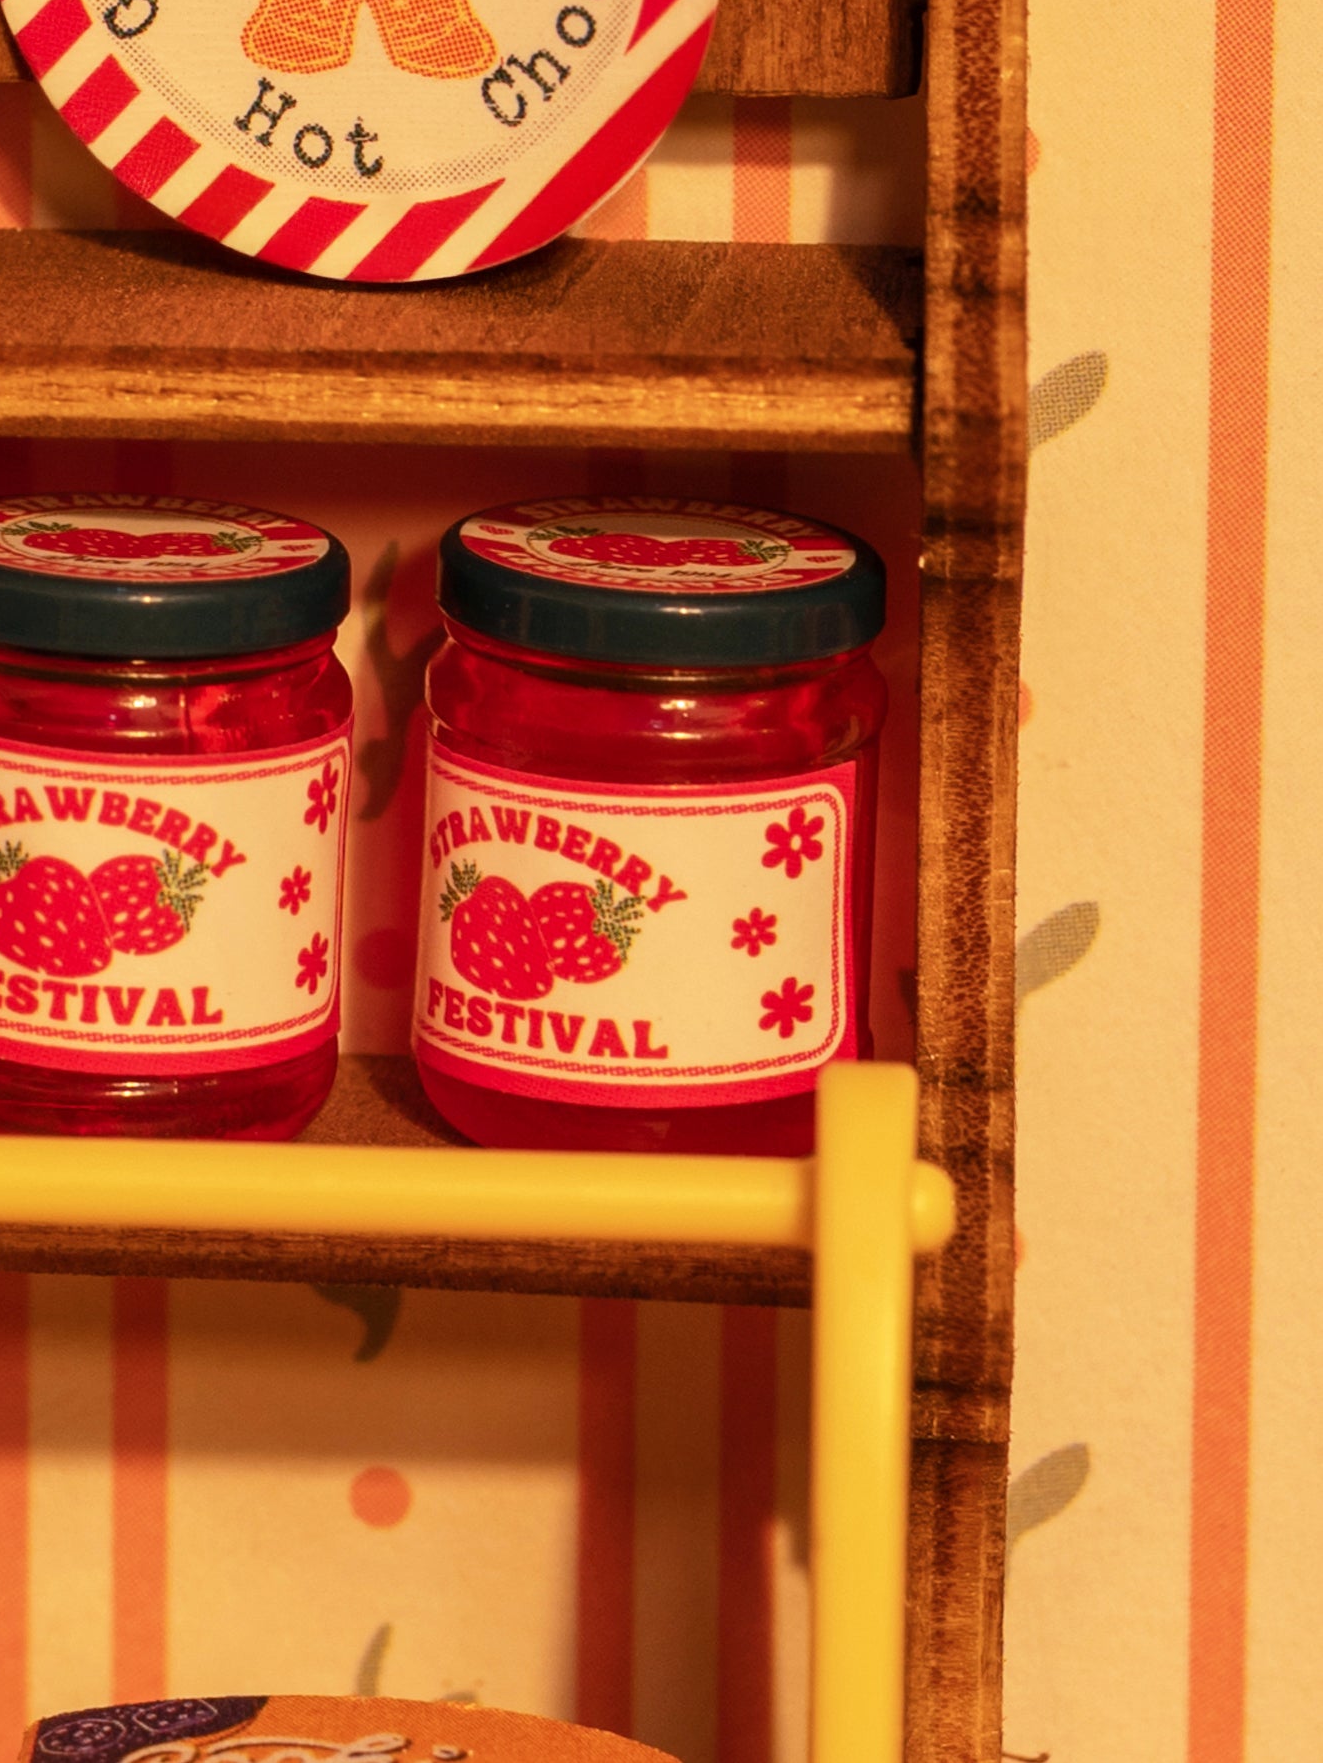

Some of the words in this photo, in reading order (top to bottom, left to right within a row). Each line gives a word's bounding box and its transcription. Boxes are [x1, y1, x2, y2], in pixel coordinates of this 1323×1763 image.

[233, 78, 384, 178] Hot
[429, 804, 688, 914] STRAWBERRY
[427, 975, 669, 1060] FESTIVAL
